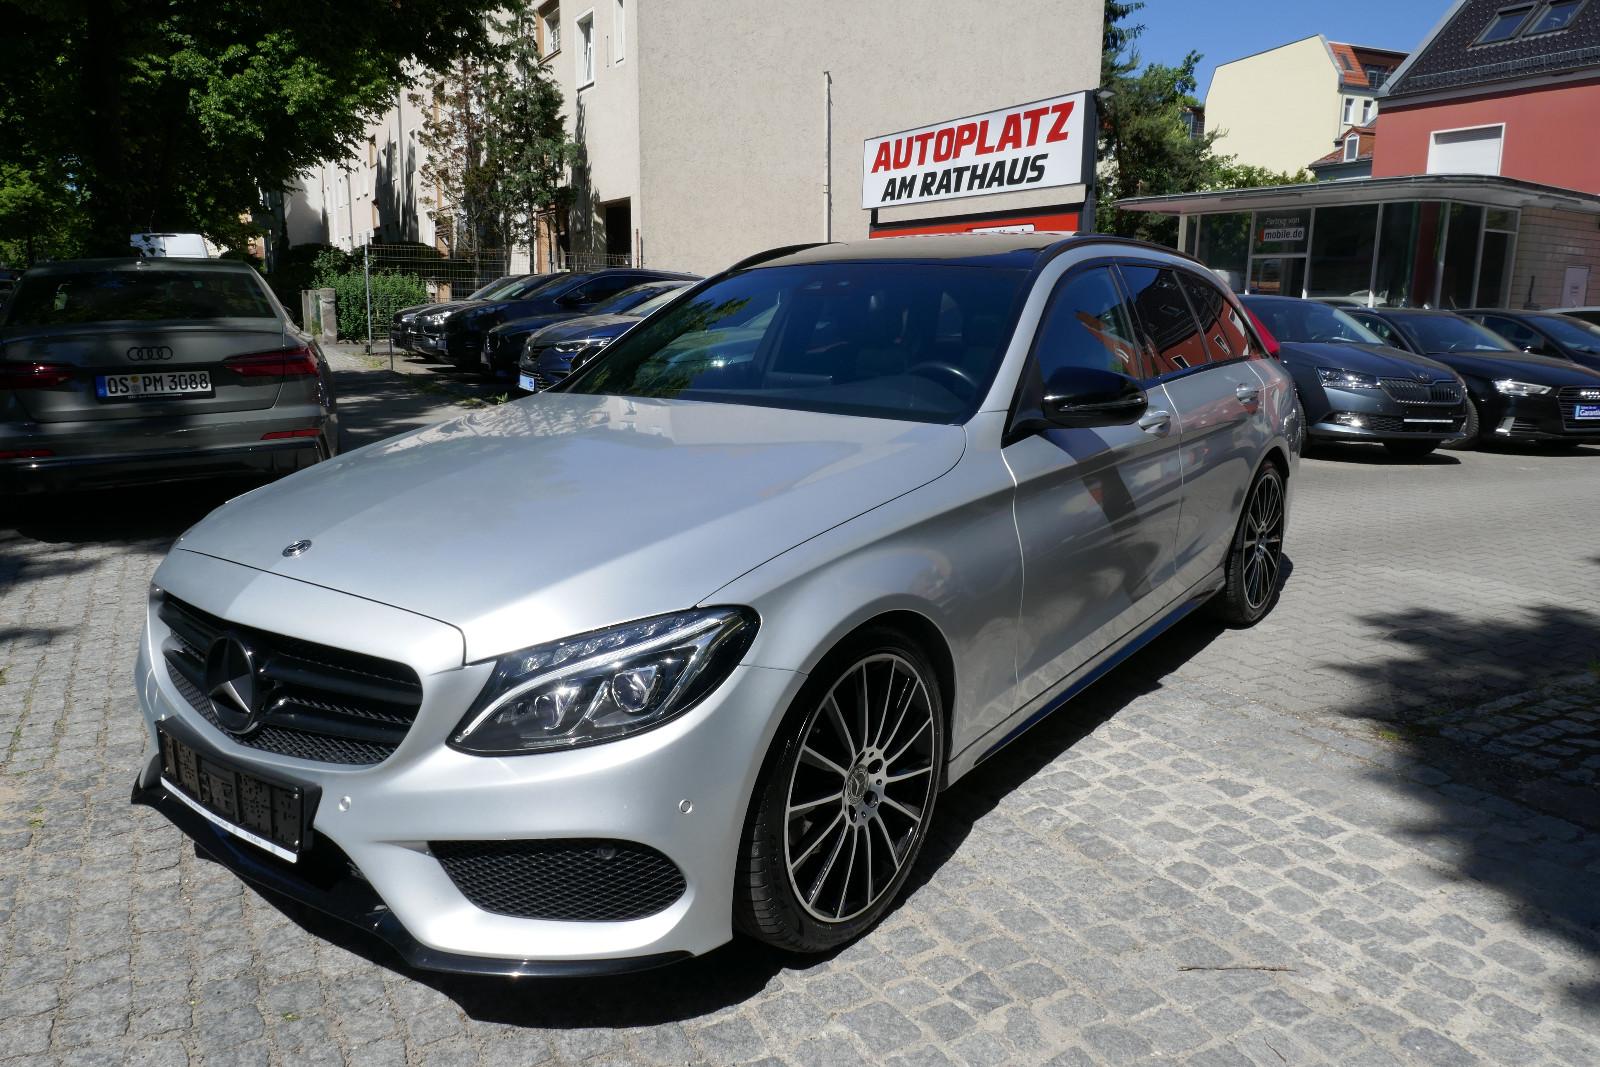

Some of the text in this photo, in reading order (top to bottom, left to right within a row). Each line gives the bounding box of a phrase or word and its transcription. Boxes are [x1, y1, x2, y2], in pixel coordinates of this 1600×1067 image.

[871, 101, 1075, 173] AUTOPLATZ
[881, 153, 1049, 202] AM RATHAUS
[1265, 229, 1302, 239] mobile.de
[107, 373, 210, 394] OS PM 3088
